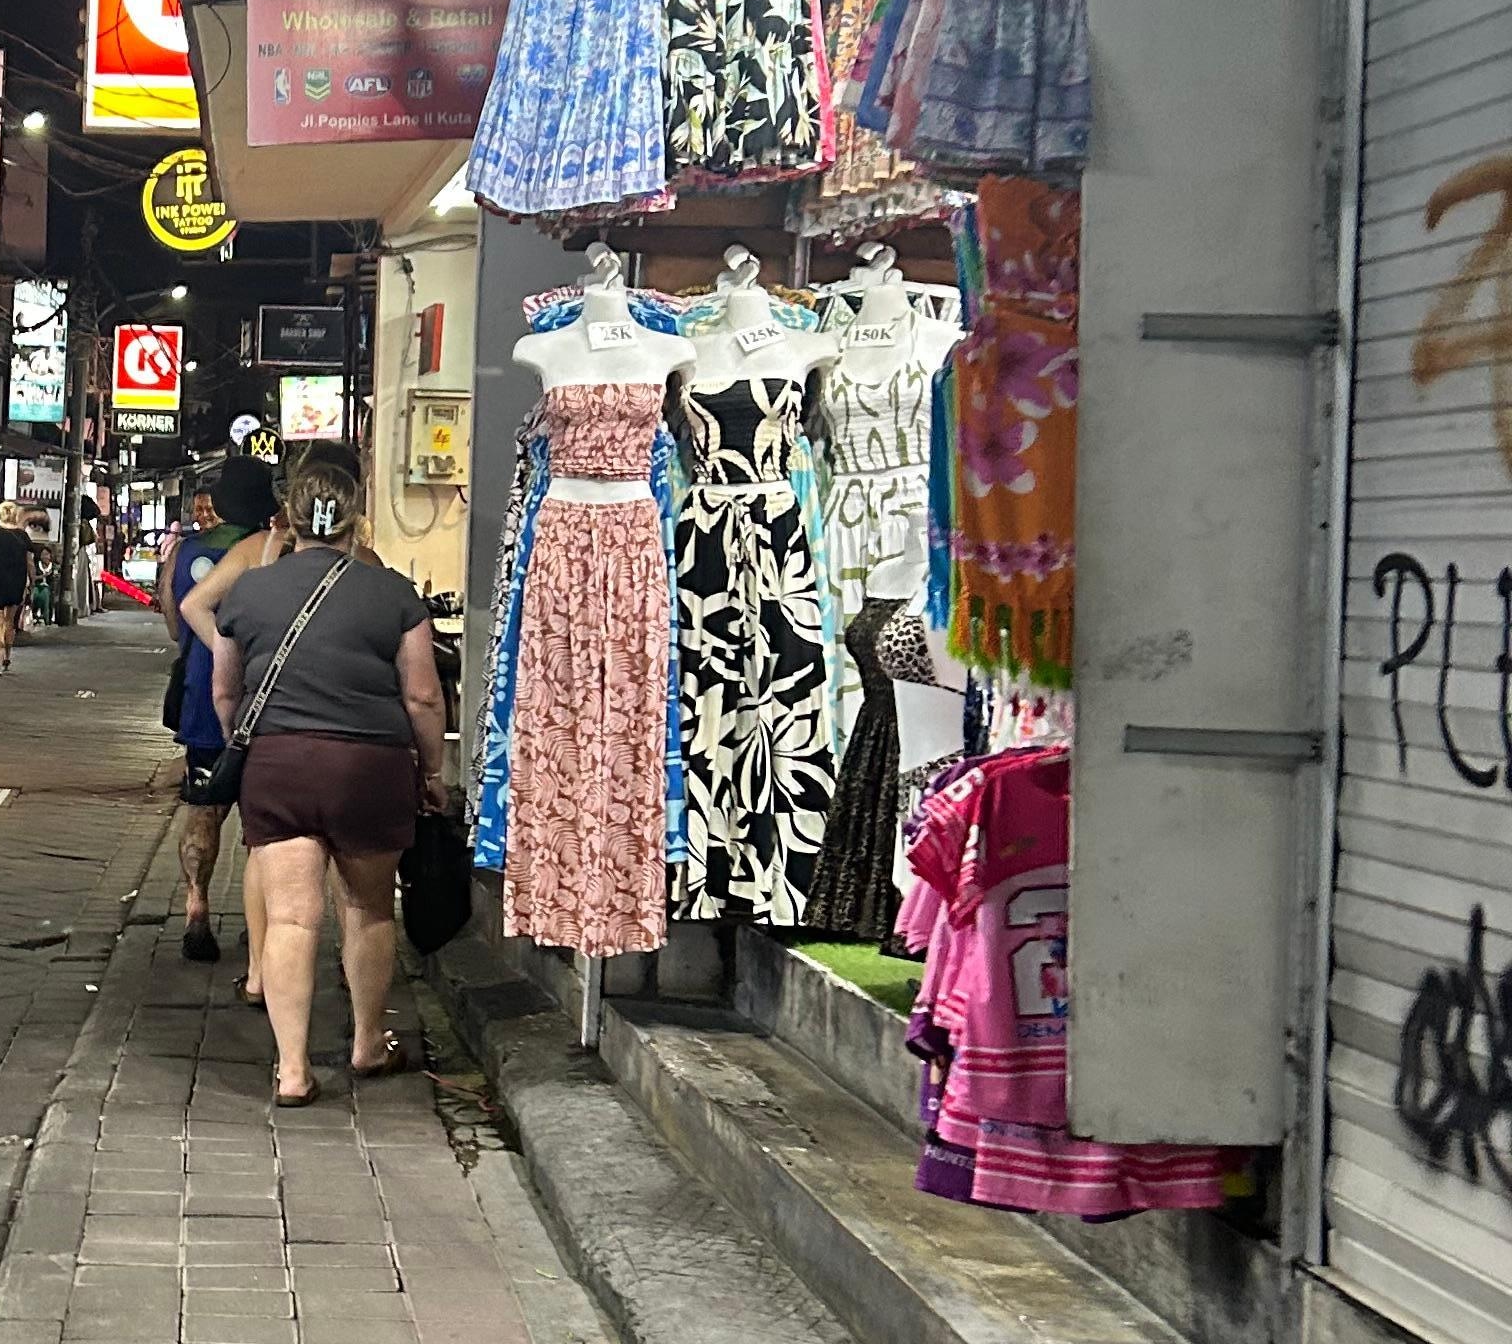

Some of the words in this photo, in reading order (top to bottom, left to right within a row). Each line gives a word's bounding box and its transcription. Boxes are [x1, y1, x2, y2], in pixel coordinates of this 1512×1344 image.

[349, 77, 389, 93] AFL
[438, 111, 472, 126] Kuta
[155, 205, 179, 219] INK
[173, 216, 214, 228] TATTOO
[741, 325, 780, 345] 125K
[854, 327, 893, 342] 150K
